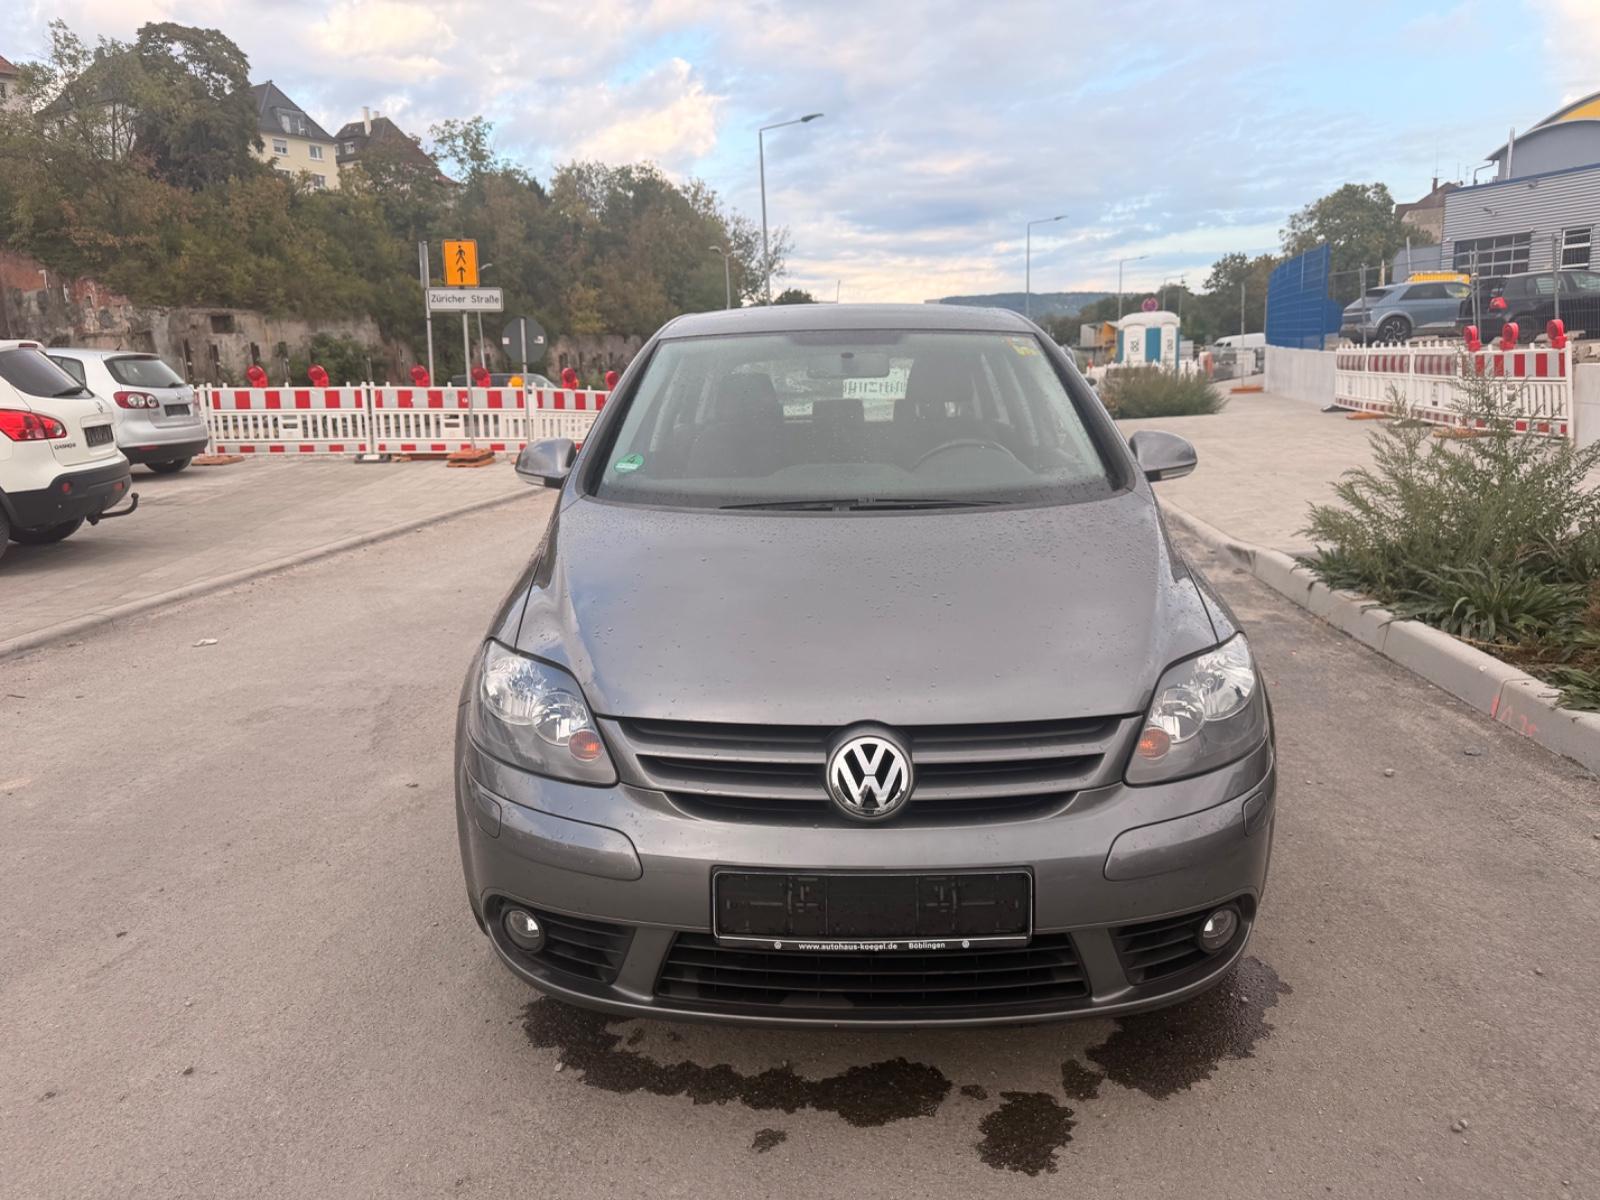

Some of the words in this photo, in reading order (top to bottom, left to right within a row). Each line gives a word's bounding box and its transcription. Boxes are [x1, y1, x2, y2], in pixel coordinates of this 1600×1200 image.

[431, 294, 466, 303] Züricher
[471, 294, 499, 303] Straße
[799, 942, 898, 951] www.autohaus-koegel.de
[908, 941, 945, 949] Böblingen
